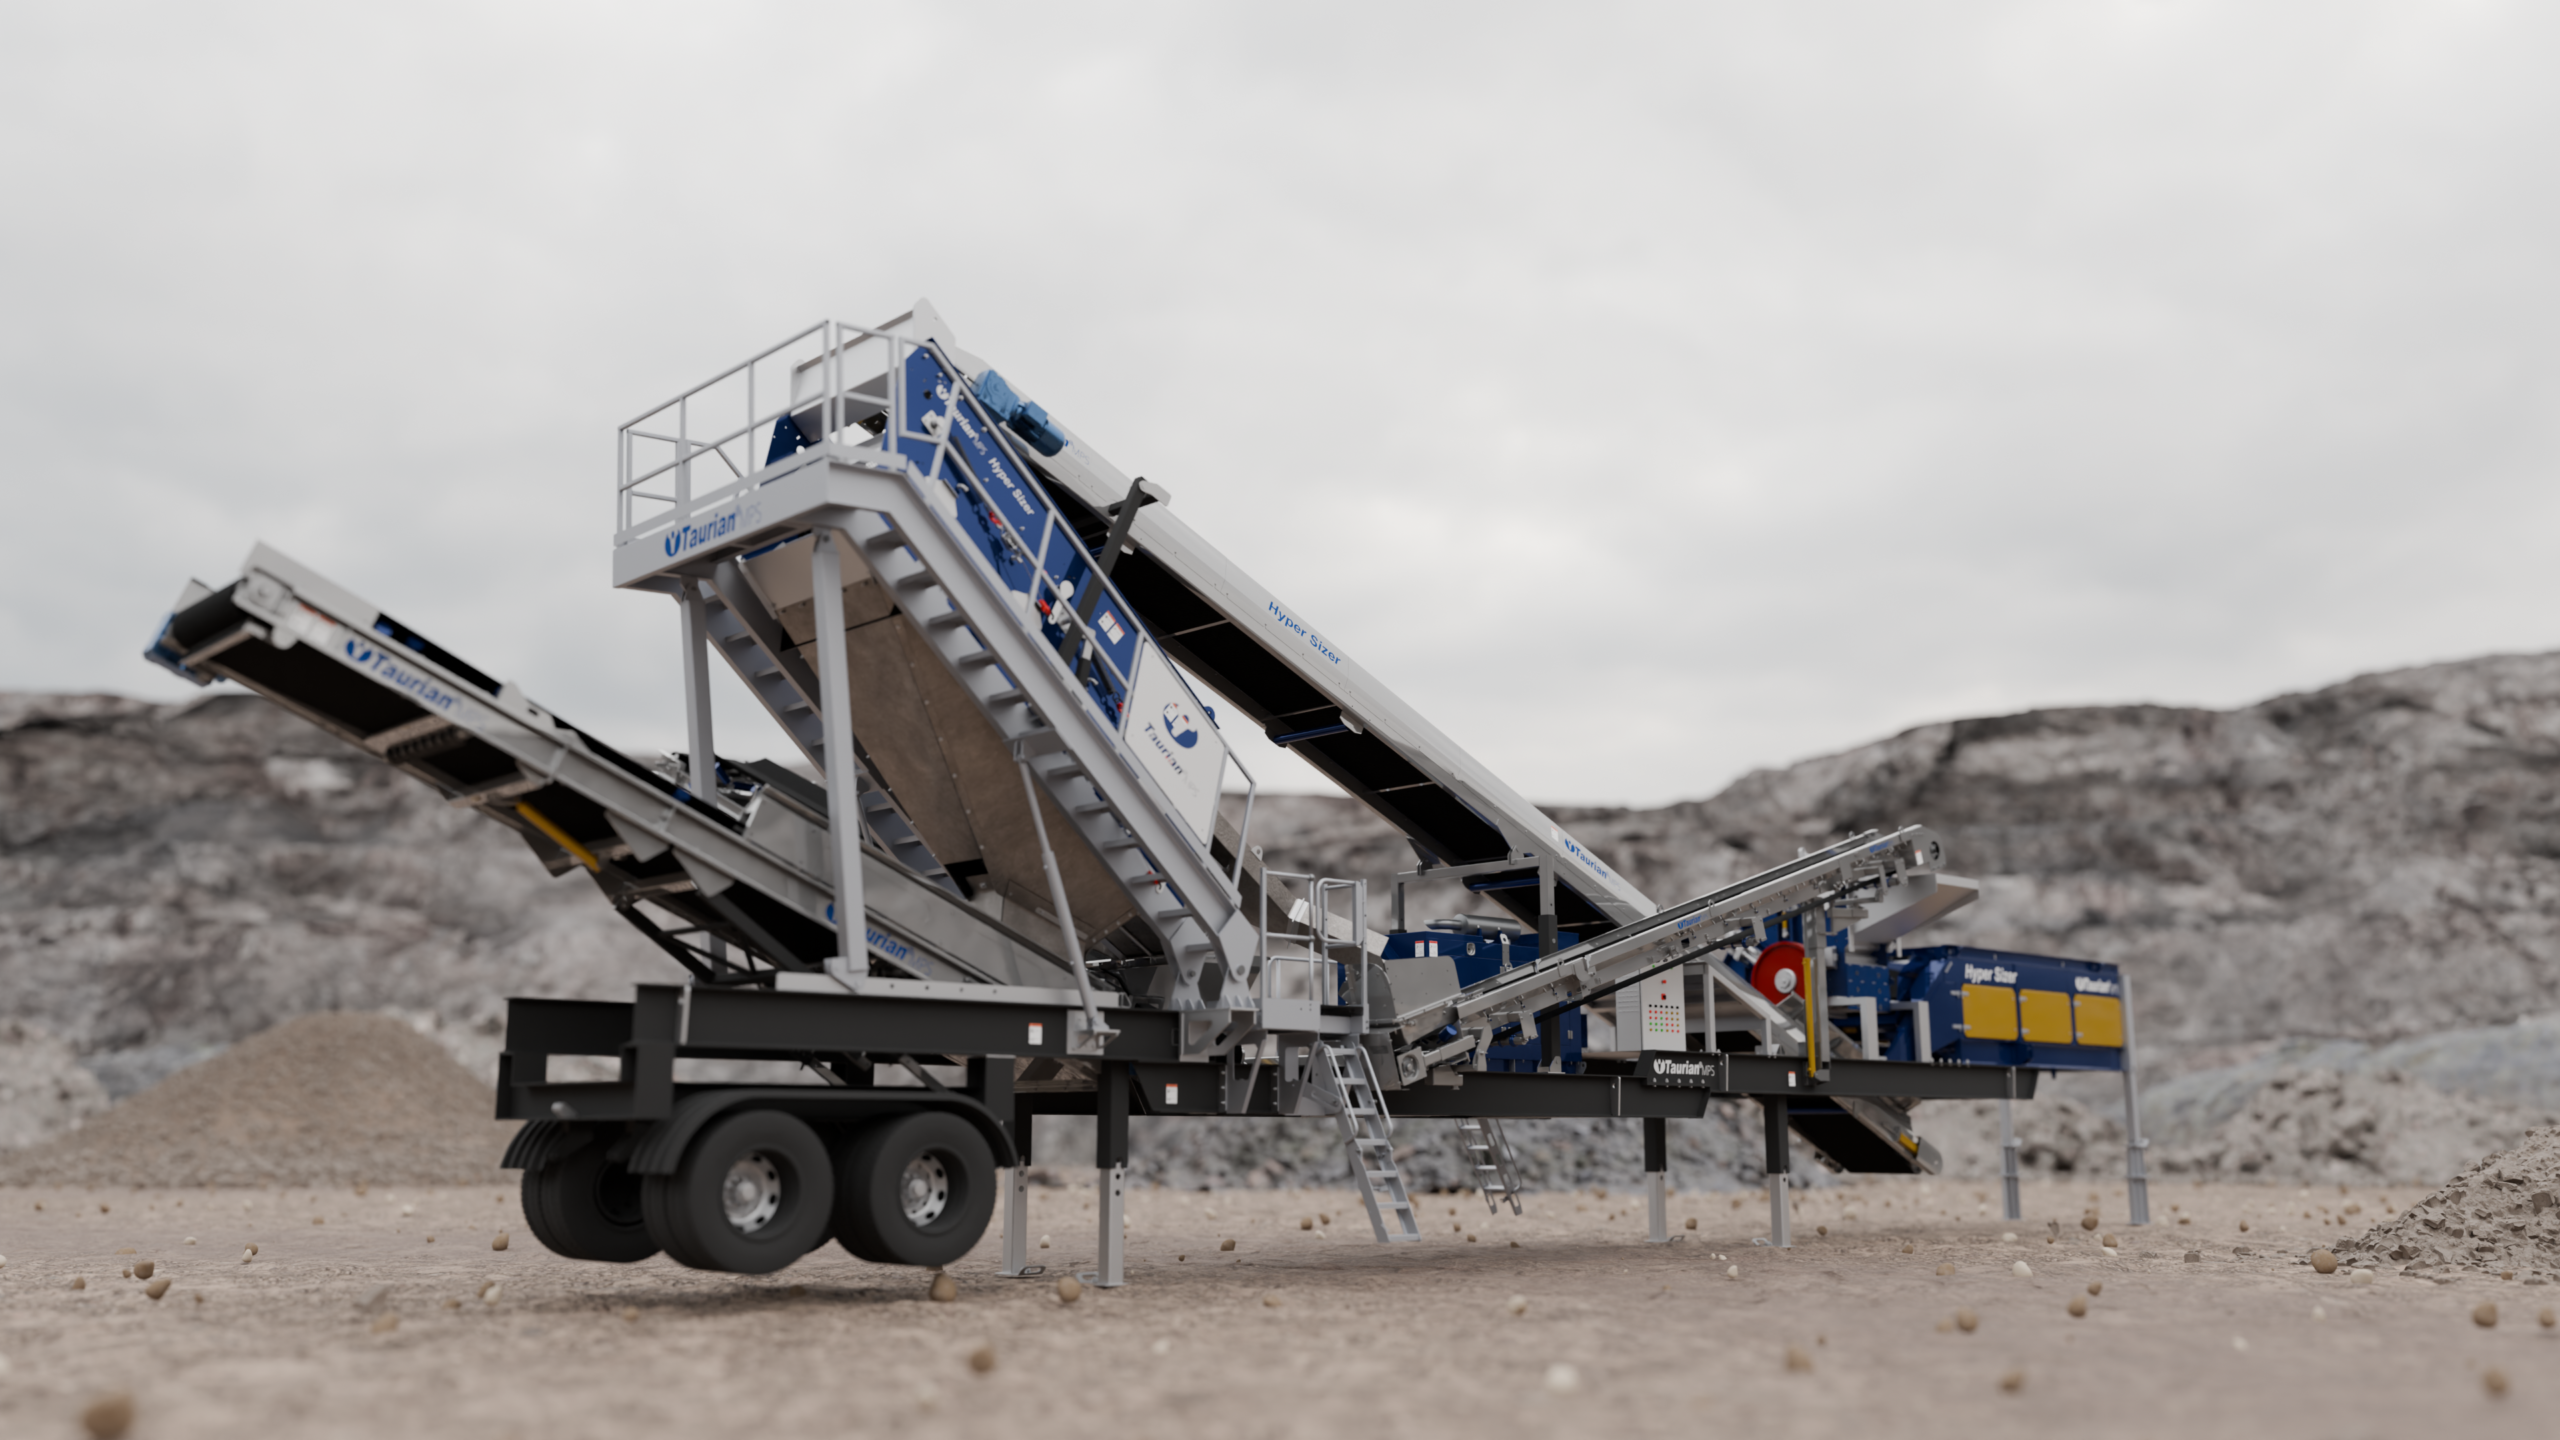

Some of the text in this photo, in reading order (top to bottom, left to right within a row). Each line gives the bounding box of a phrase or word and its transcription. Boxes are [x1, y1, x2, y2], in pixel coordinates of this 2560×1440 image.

[988, 457, 1015, 489] Hyper
[1012, 488, 1035, 515] Sizer
[683, 512, 736, 551] Taurian
[1268, 601, 1341, 665] Hyper Sizer
[370, 652, 453, 710] Taurian
[1145, 722, 1183, 775] Taurian
[1575, 846, 1607, 879] Taurian
[866, 927, 907, 960] urian
[1665, 1060, 1700, 1075] Taurian
